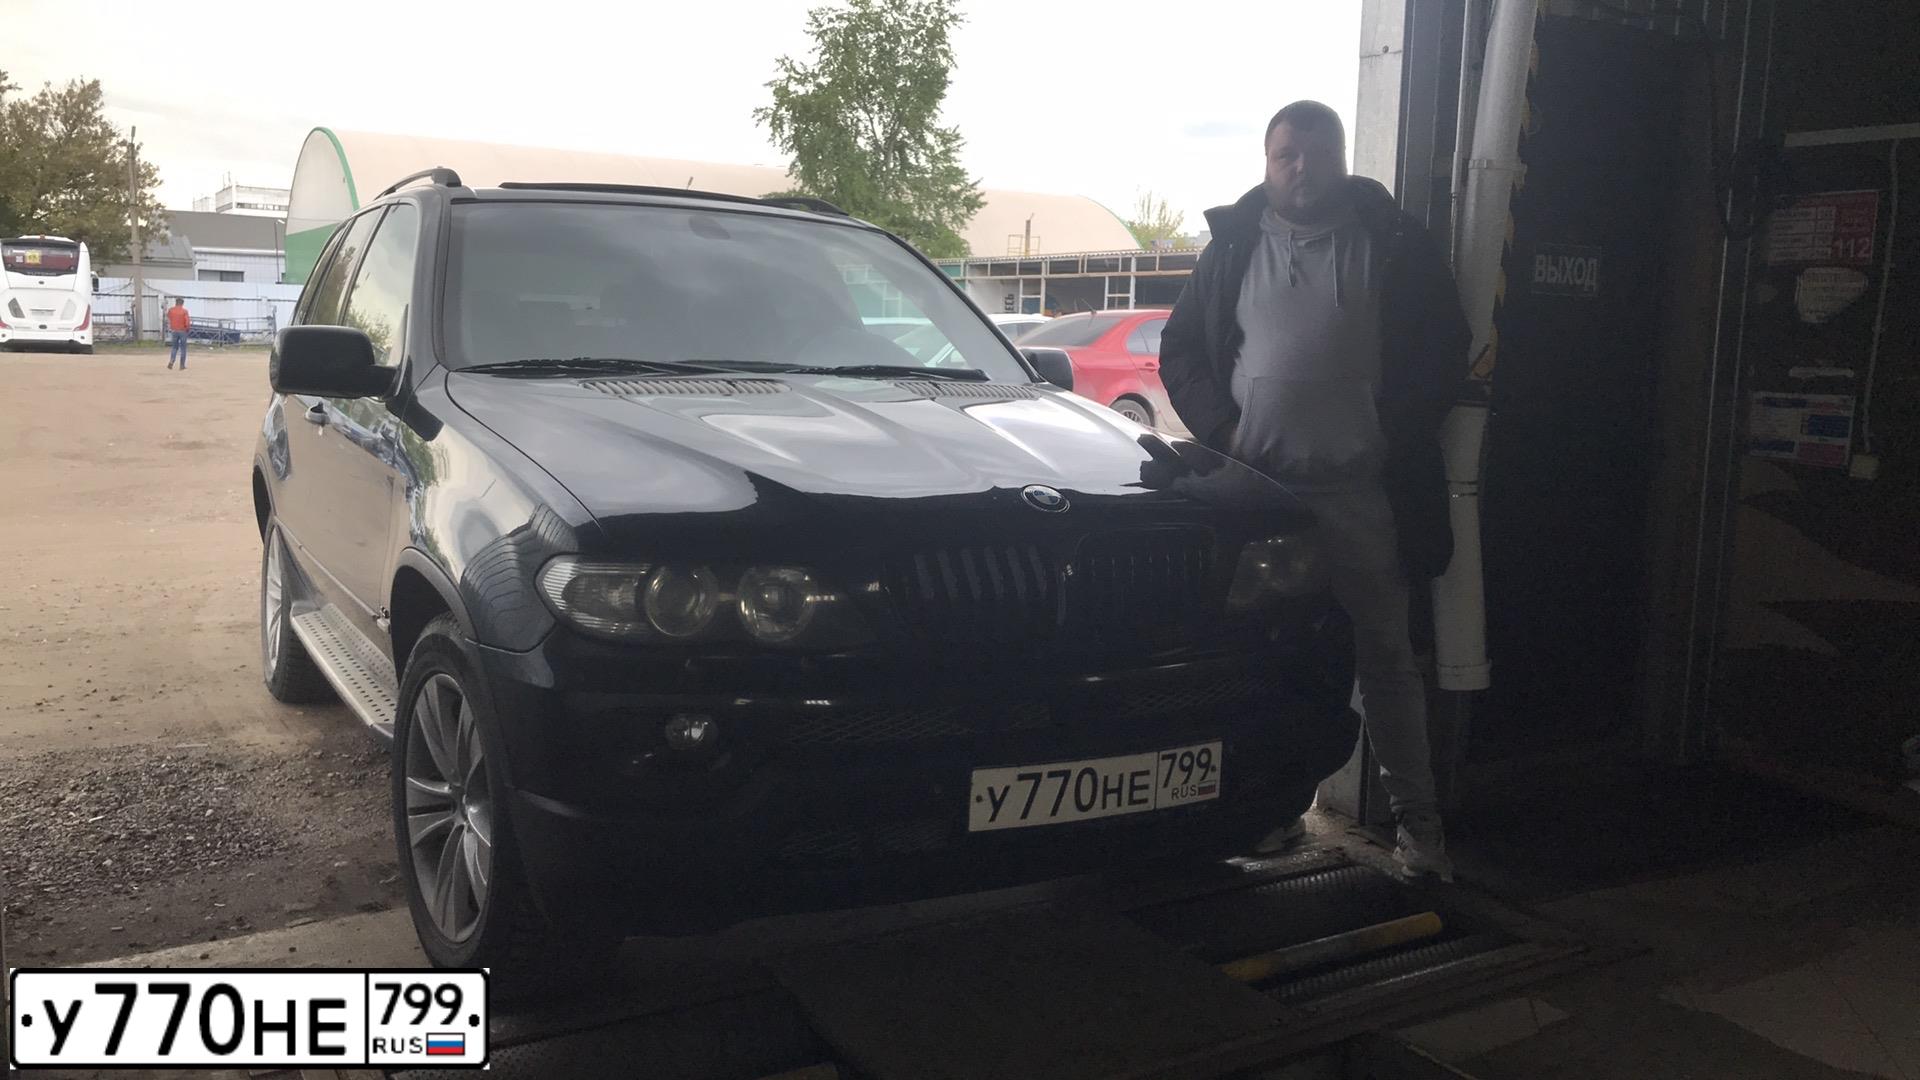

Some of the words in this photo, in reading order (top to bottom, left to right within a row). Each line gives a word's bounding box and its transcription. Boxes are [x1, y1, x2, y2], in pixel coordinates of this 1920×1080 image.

[1834, 237, 1871, 258] 112
[1536, 254, 1598, 292] ВЫХОД
[987, 767, 1150, 822] У770НЕ
[1161, 748, 1212, 788] 799
[1171, 785, 1199, 800] RUS
